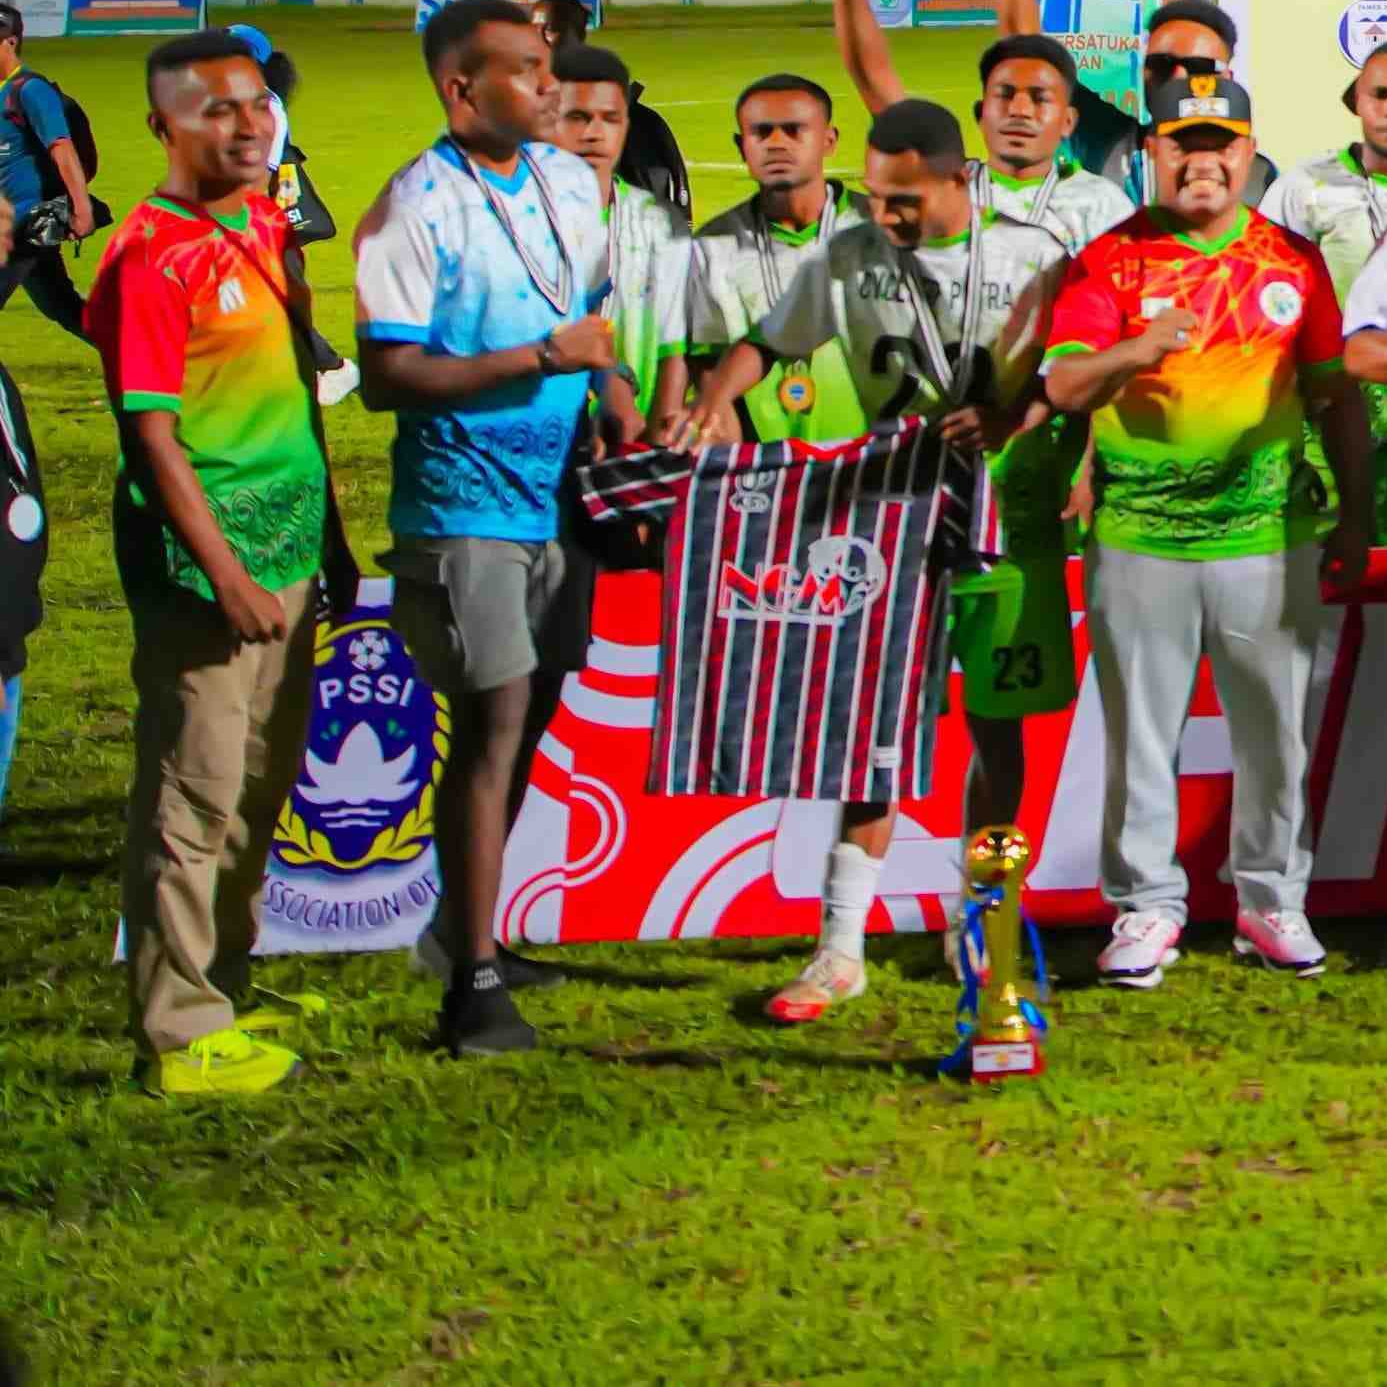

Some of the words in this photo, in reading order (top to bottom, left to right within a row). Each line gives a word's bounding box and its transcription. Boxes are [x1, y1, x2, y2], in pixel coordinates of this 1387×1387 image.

[318, 674, 416, 710] PSSI
[991, 645, 1043, 692] 23
[262, 871, 403, 930] SSOCIATION
